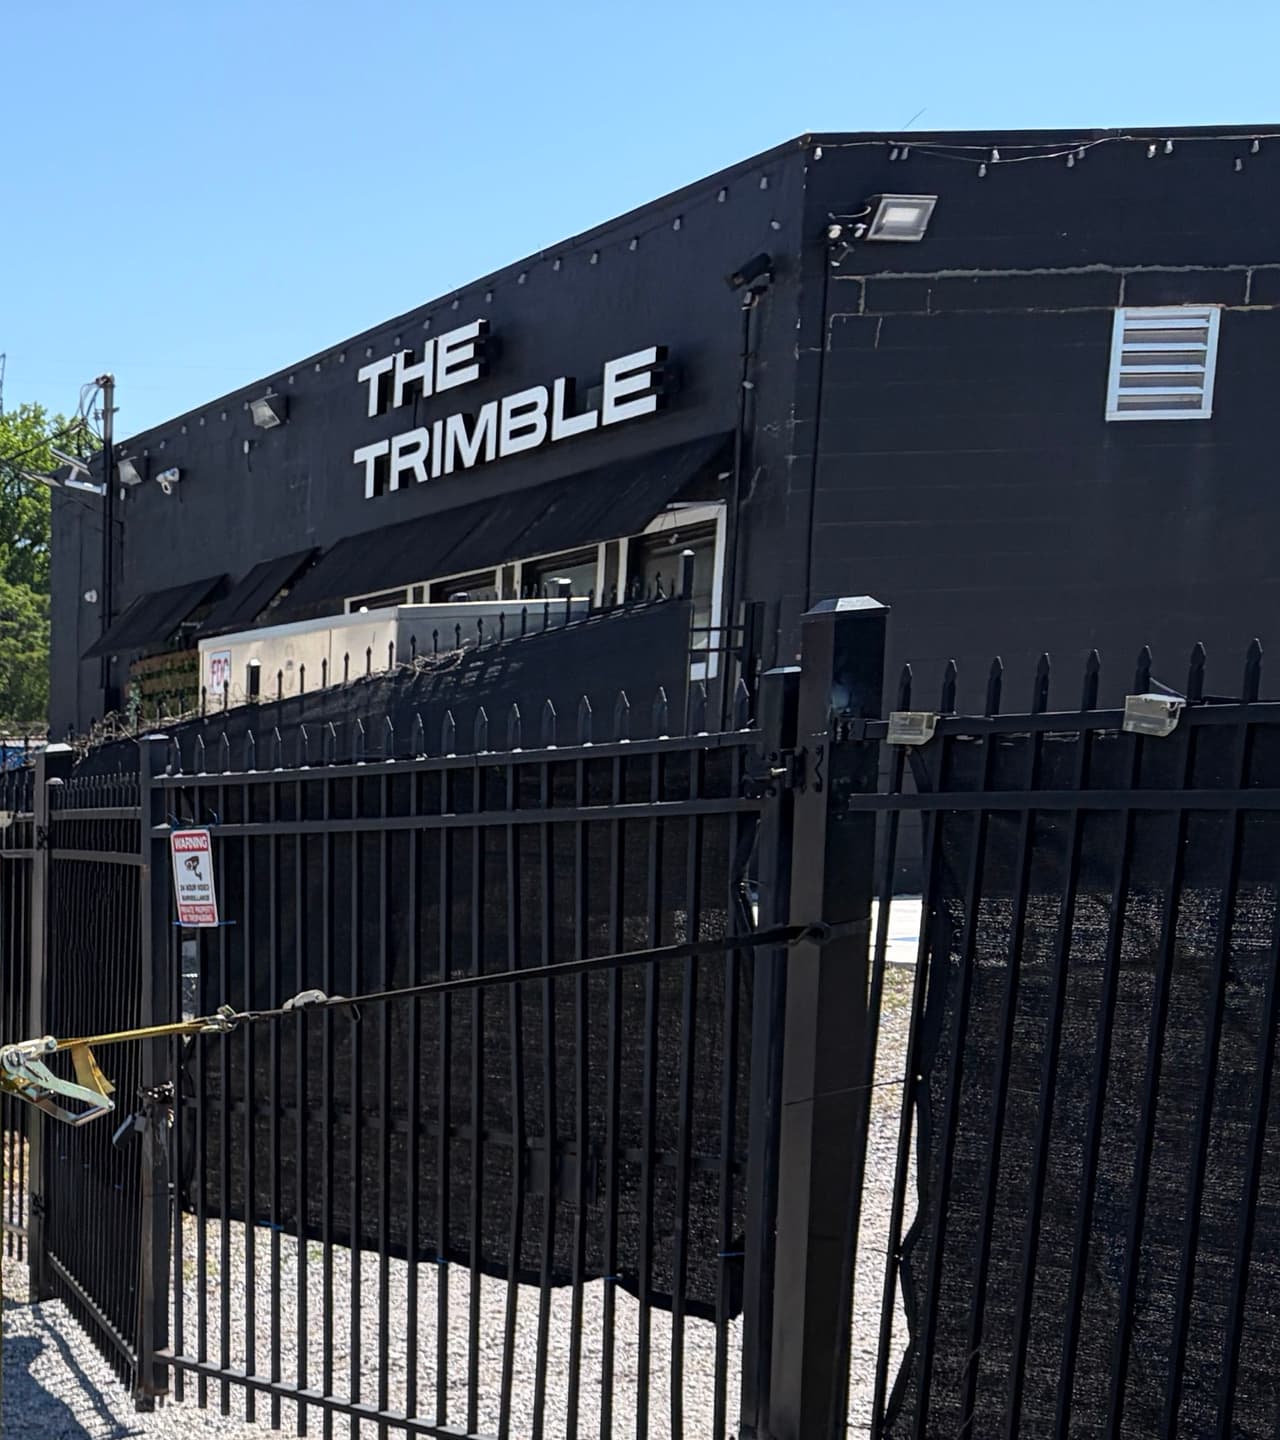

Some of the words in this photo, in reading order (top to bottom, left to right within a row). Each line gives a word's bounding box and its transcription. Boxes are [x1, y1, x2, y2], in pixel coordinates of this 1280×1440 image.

[357, 319, 486, 418] THE
[353, 346, 658, 500] TRIMBLE
[175, 835, 208, 849] WARNING
